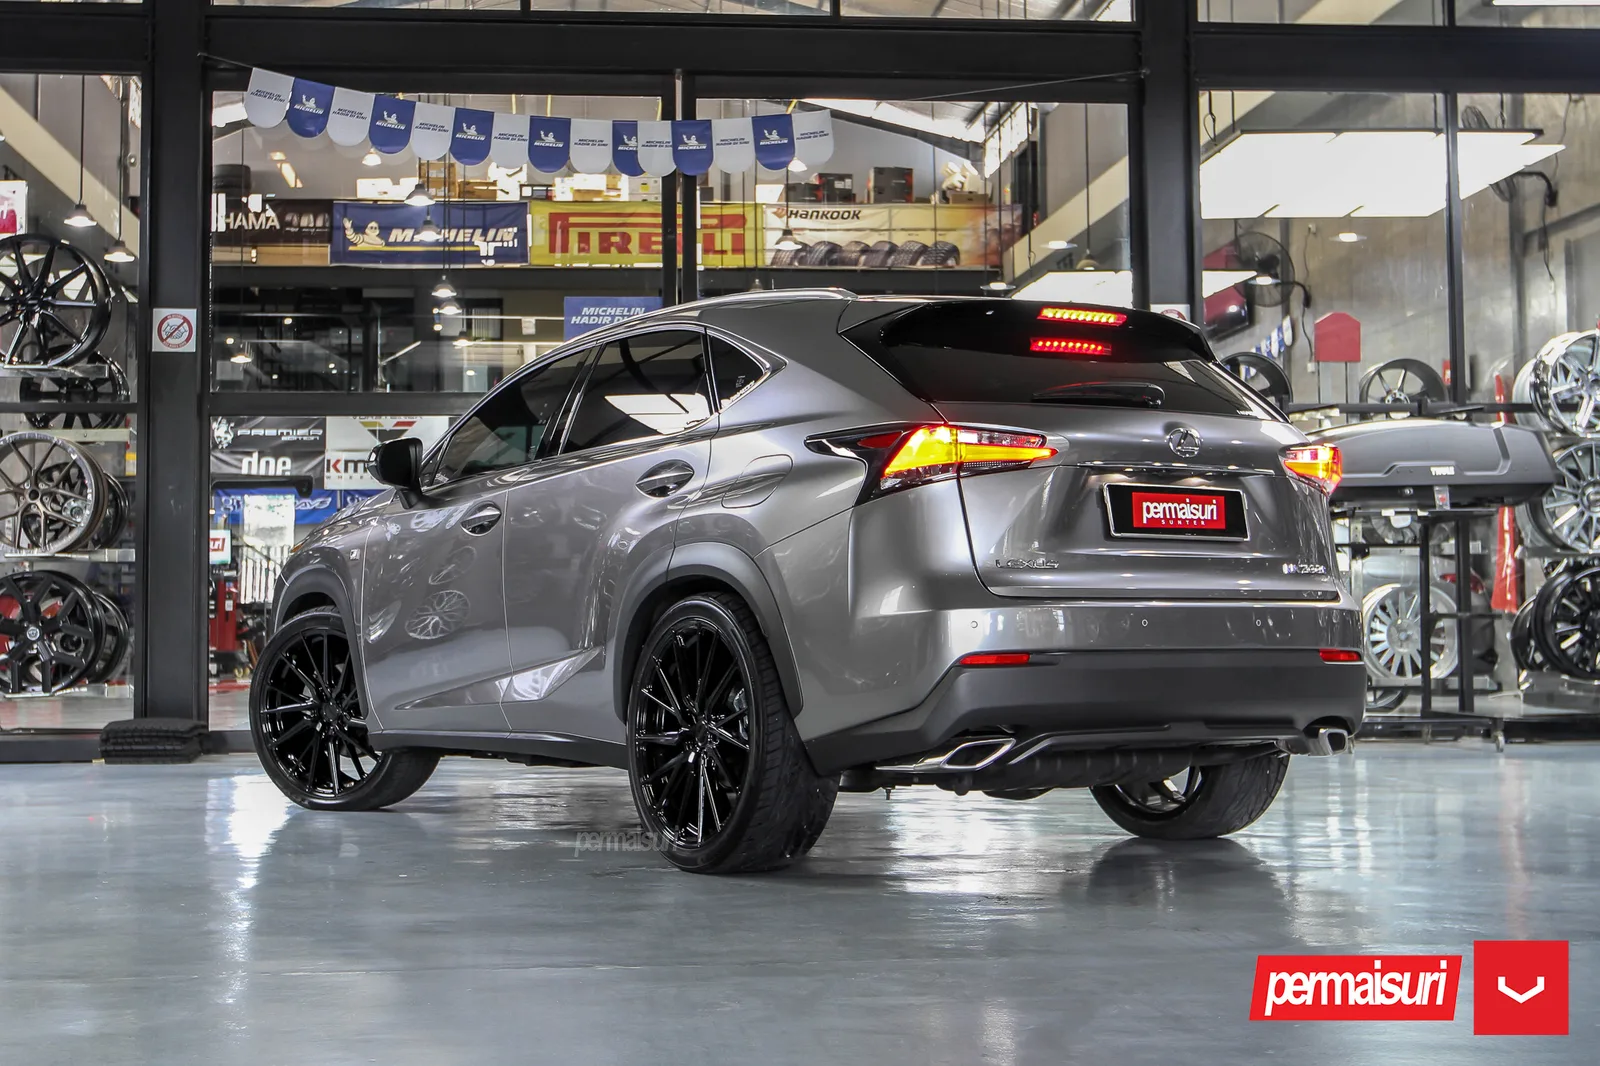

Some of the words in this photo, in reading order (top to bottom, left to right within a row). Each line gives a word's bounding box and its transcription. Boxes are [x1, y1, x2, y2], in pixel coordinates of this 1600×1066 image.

[294, 104, 324, 114] MICHELIN
[376, 121, 406, 130] MICHELIN
[389, 228, 516, 242] MHELIN
[549, 212, 746, 255] PIRELI
[582, 307, 645, 315] MICHELIN
[571, 316, 611, 324] HADIR
[1142, 498, 1217, 524] permaisuri
